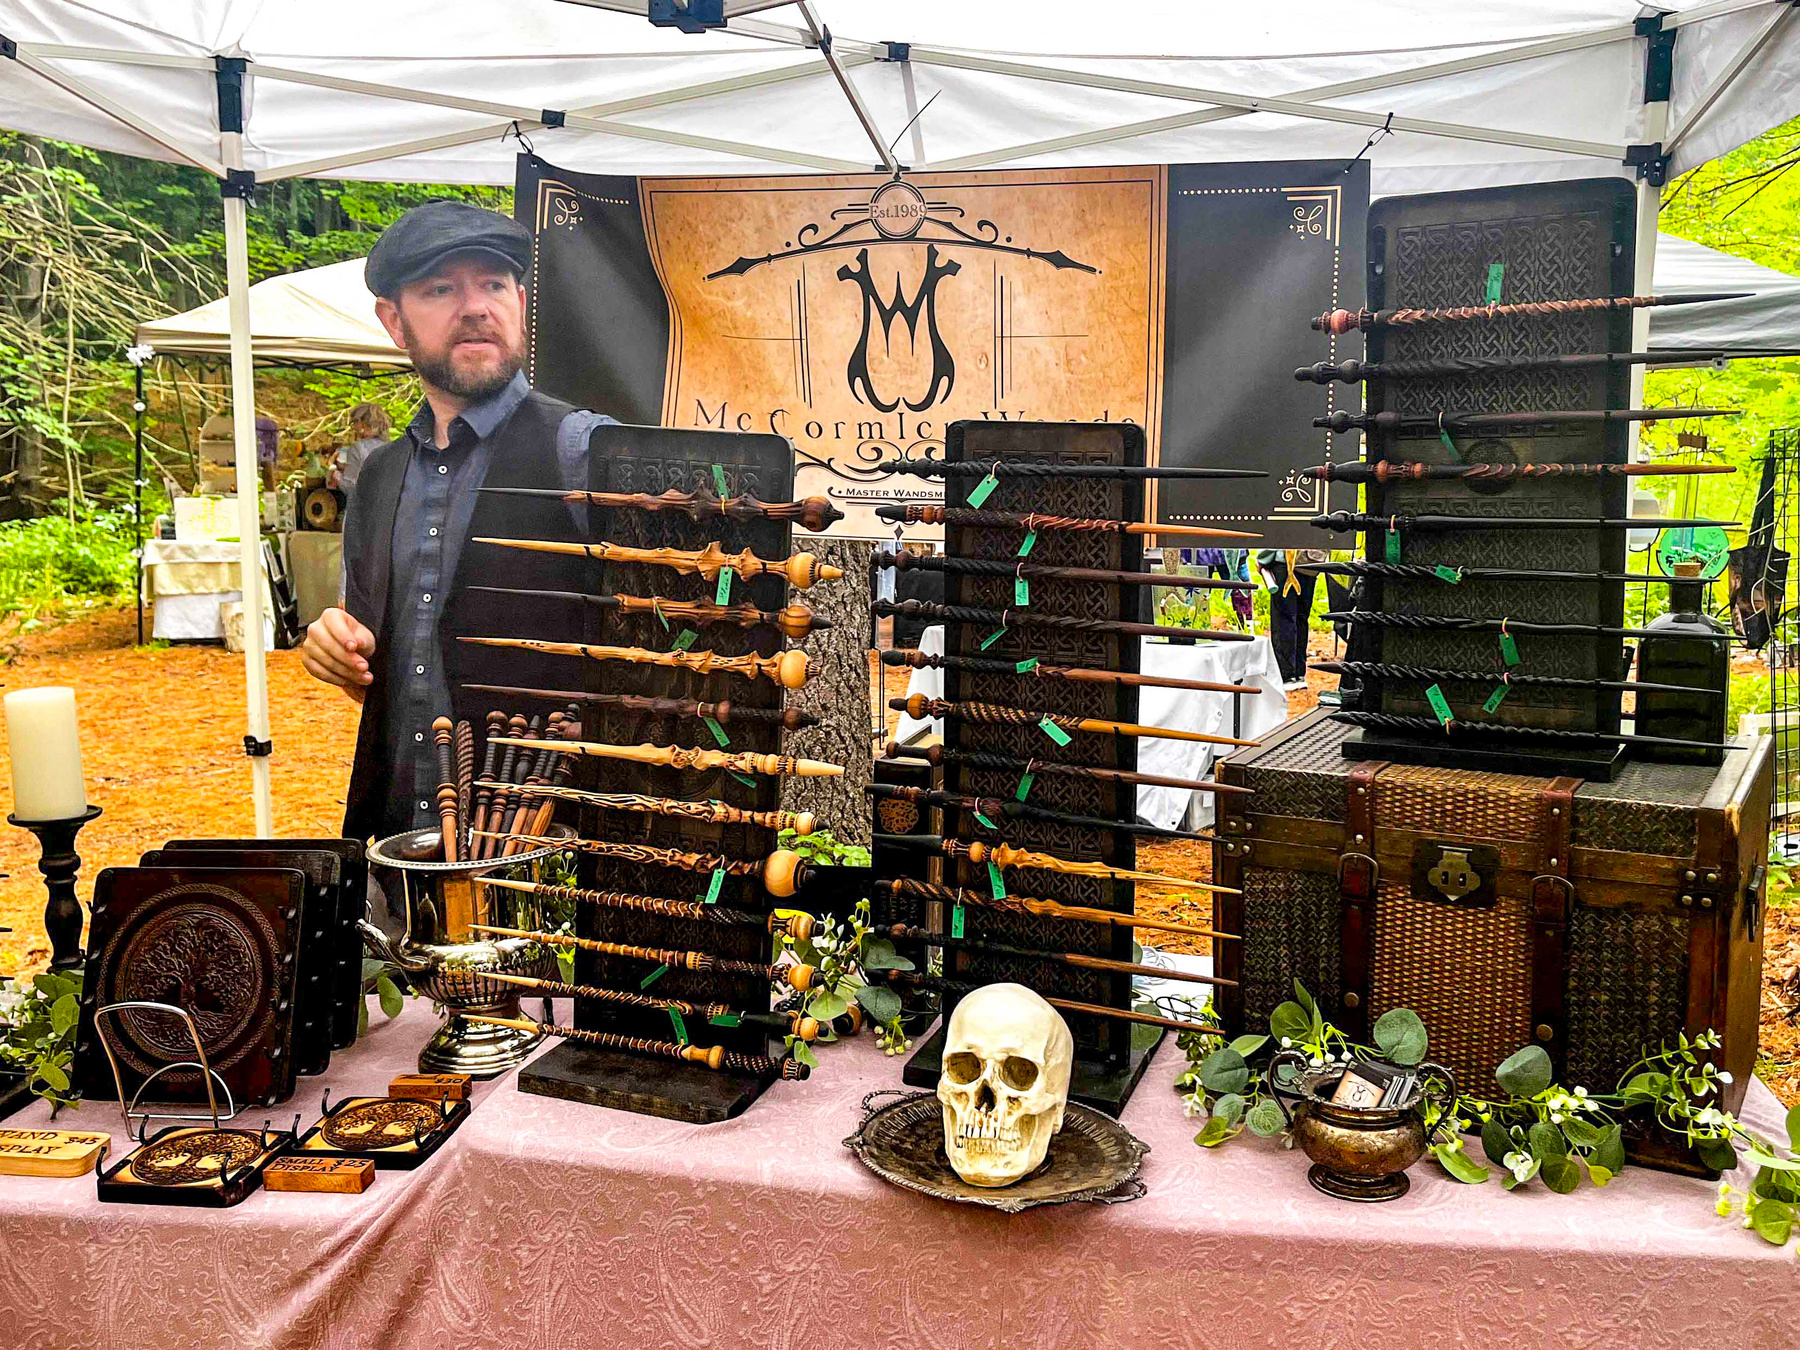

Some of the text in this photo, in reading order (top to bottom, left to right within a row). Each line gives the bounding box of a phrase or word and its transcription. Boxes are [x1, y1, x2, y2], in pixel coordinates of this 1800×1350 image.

[869, 204, 927, 219] Est.1989
[846, 488, 889, 497] MASTER
[64, 1136, 101, 1145] $45
[276, 1157, 324, 1165] SMALL
[332, 1158, 369, 1168] $25
[270, 1163, 340, 1172] DISPLAY
